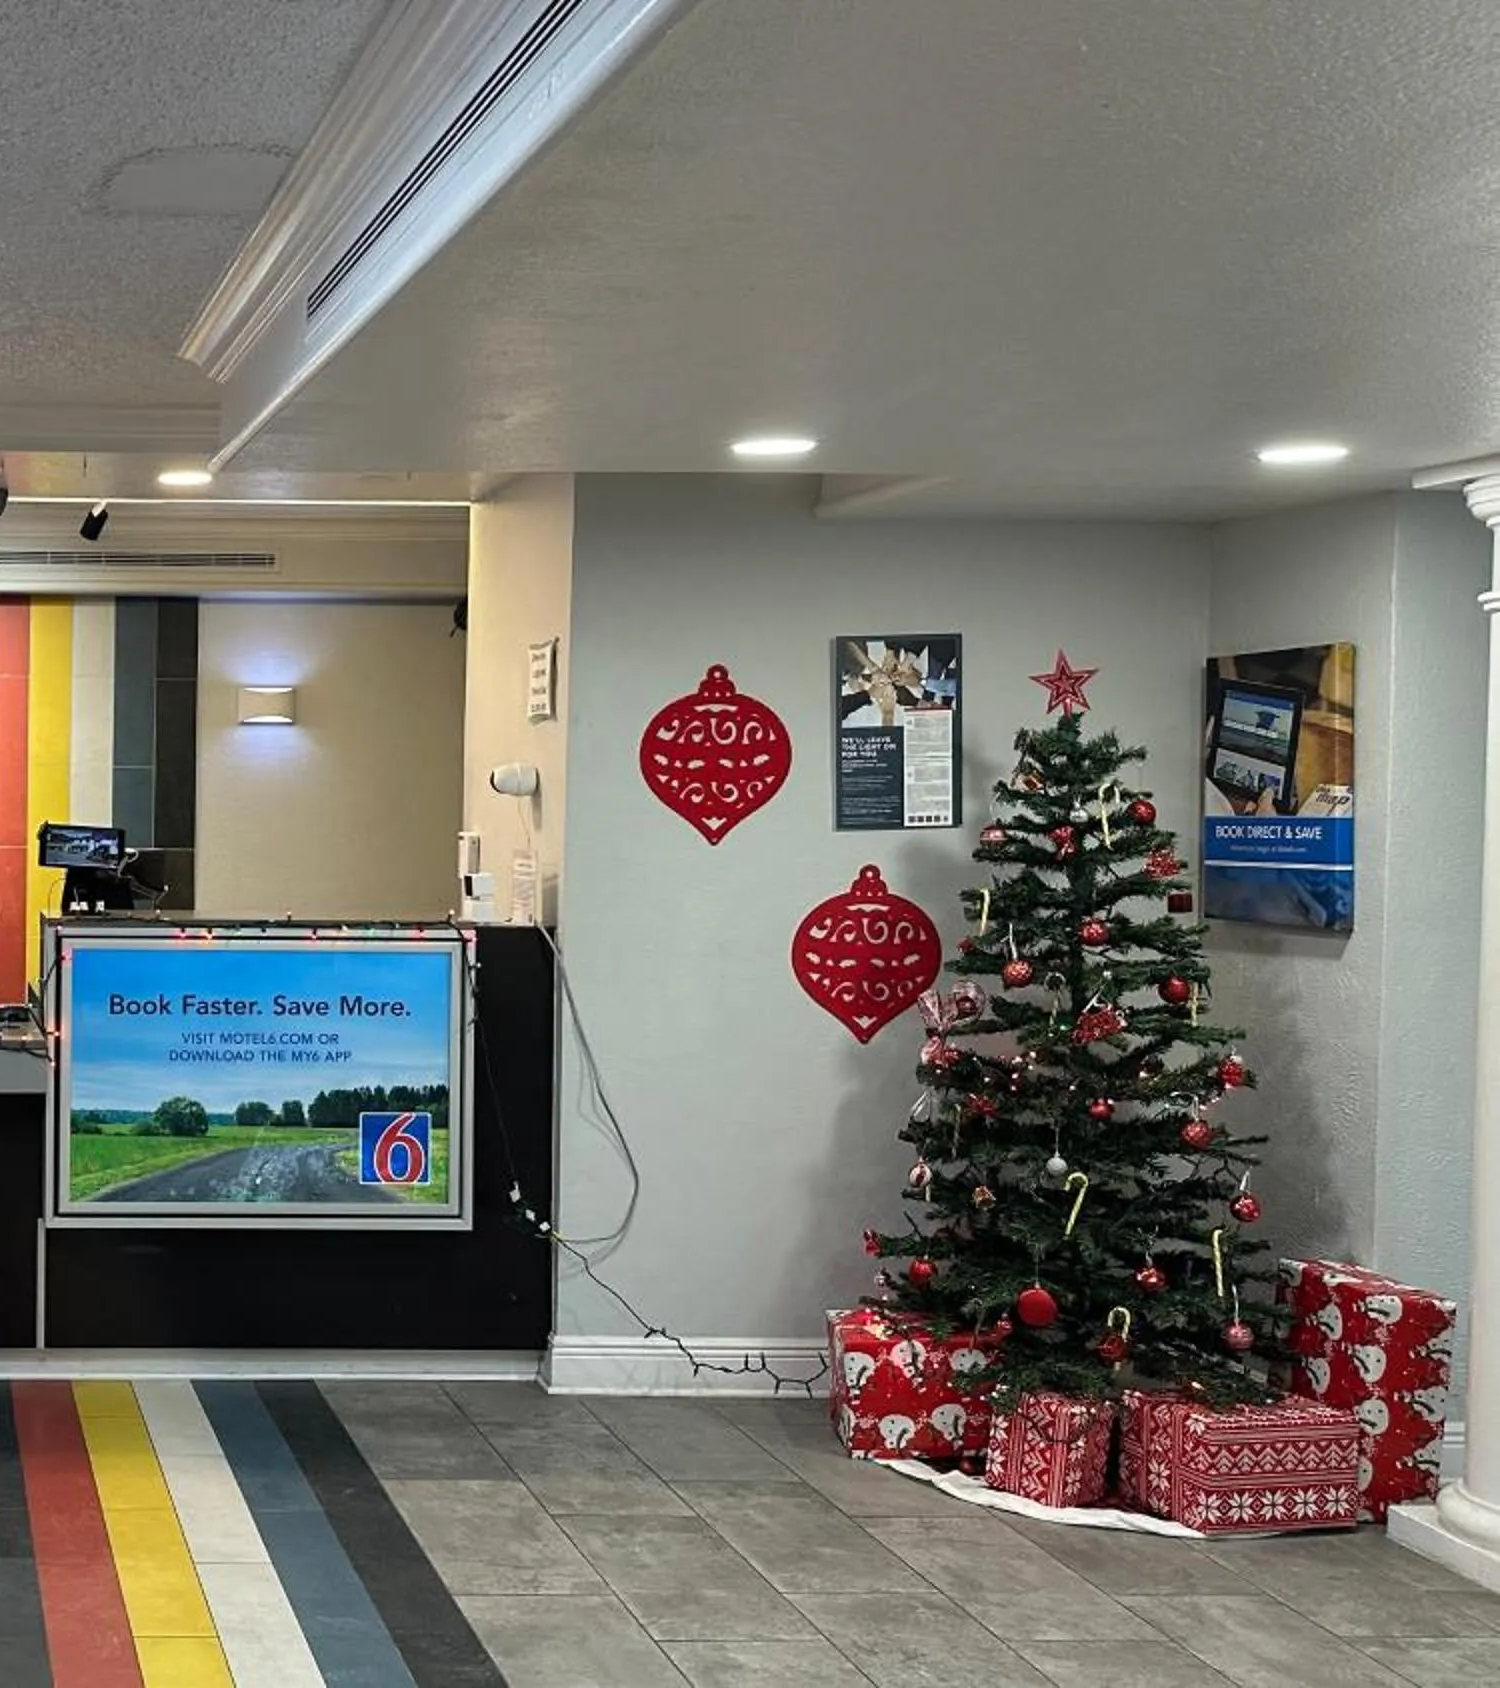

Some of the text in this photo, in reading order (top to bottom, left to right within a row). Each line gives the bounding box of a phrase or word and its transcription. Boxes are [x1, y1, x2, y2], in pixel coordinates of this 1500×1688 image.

[1215, 825, 1323, 839] BOOK DIRECT & SAVE
[109, 992, 412, 1017] Book Faster. Save More.
[181, 1032, 339, 1045] VISIT MOTEL6.COM OR
[168, 1049, 353, 1063] DOWNLOAD THE MY6 APP
[373, 1112, 426, 1183] 6
